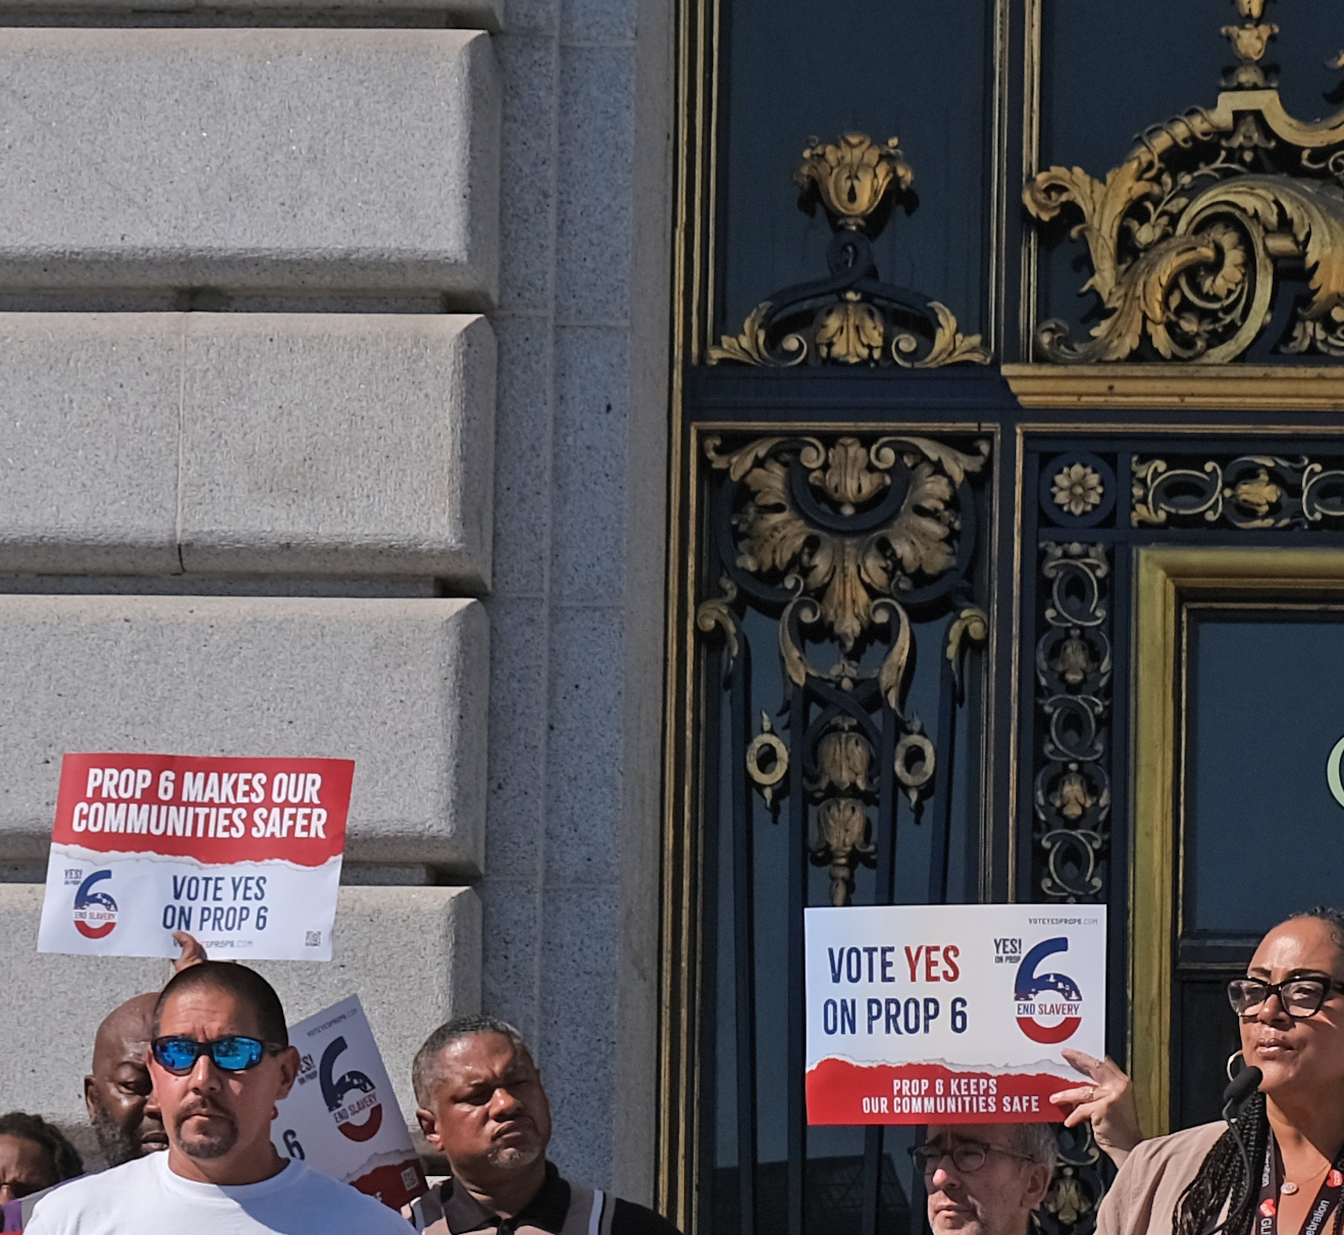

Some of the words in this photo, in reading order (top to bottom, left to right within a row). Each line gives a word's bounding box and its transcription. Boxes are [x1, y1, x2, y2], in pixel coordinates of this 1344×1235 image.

[86, 768, 151, 798] PROP
[158, 772, 174, 799] 6
[182, 771, 265, 803] MAKES
[272, 773, 321, 804] OUR
[72, 803, 246, 838] COMMUNITIES
[251, 807, 327, 839] SAFER
[173, 875, 225, 901] VOTE
[231, 876, 267, 901] YES
[162, 904, 193, 931] ON
[199, 906, 250, 931] PROP
[255, 905, 268, 931] 6
[993, 938, 1022, 955] YES!
[828, 946, 895, 983] VOTE
[904, 945, 960, 982] YES
[823, 998, 856, 1035] ON
[867, 997, 940, 1035] PROP
[951, 997, 967, 1033] 6
[1017, 1003, 1036, 1015] END
[1038, 1003, 1080, 1015] SLAVERY
[298, 1054, 316, 1076] ES!
[893, 1079, 930, 1095] PROP
[935, 1079, 944, 1095] 6
[951, 1078, 997, 1095] KEEPS
[862, 1096, 888, 1114] OUR
[893, 1096, 996, 1113] COMMUNITIES
[1002, 1095, 1040, 1112] SAFE
